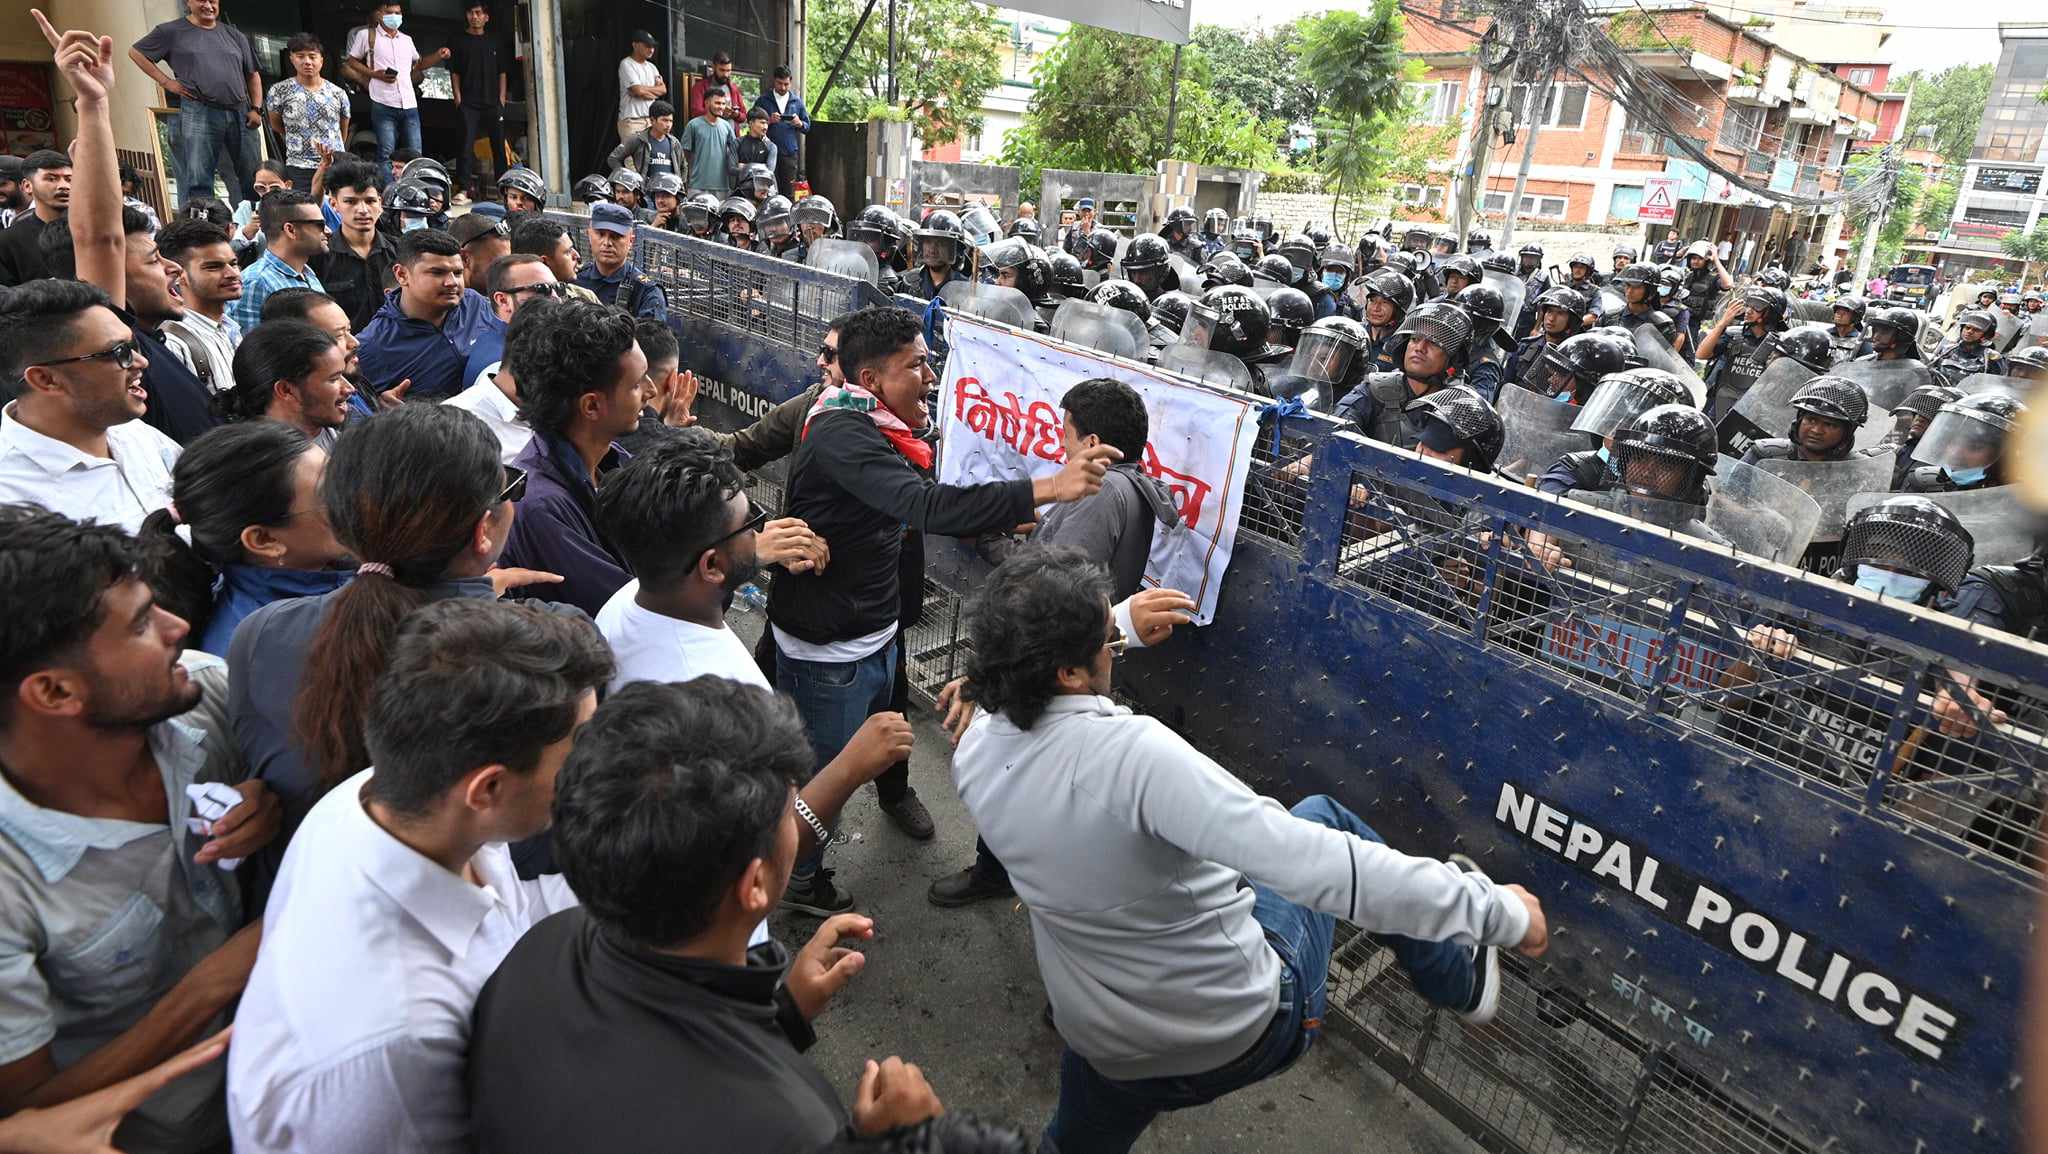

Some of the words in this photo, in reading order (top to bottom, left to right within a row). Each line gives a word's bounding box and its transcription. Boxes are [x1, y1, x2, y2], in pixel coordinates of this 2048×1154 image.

[1222, 303, 1253, 311] POLICE
[1730, 365, 1762, 378] POLICE
[696, 375, 727, 404] EPAL
[730, 387, 777, 418] POLIC
[1495, 782, 1669, 910] NEPAL
[1686, 885, 1956, 1060] POLICE
